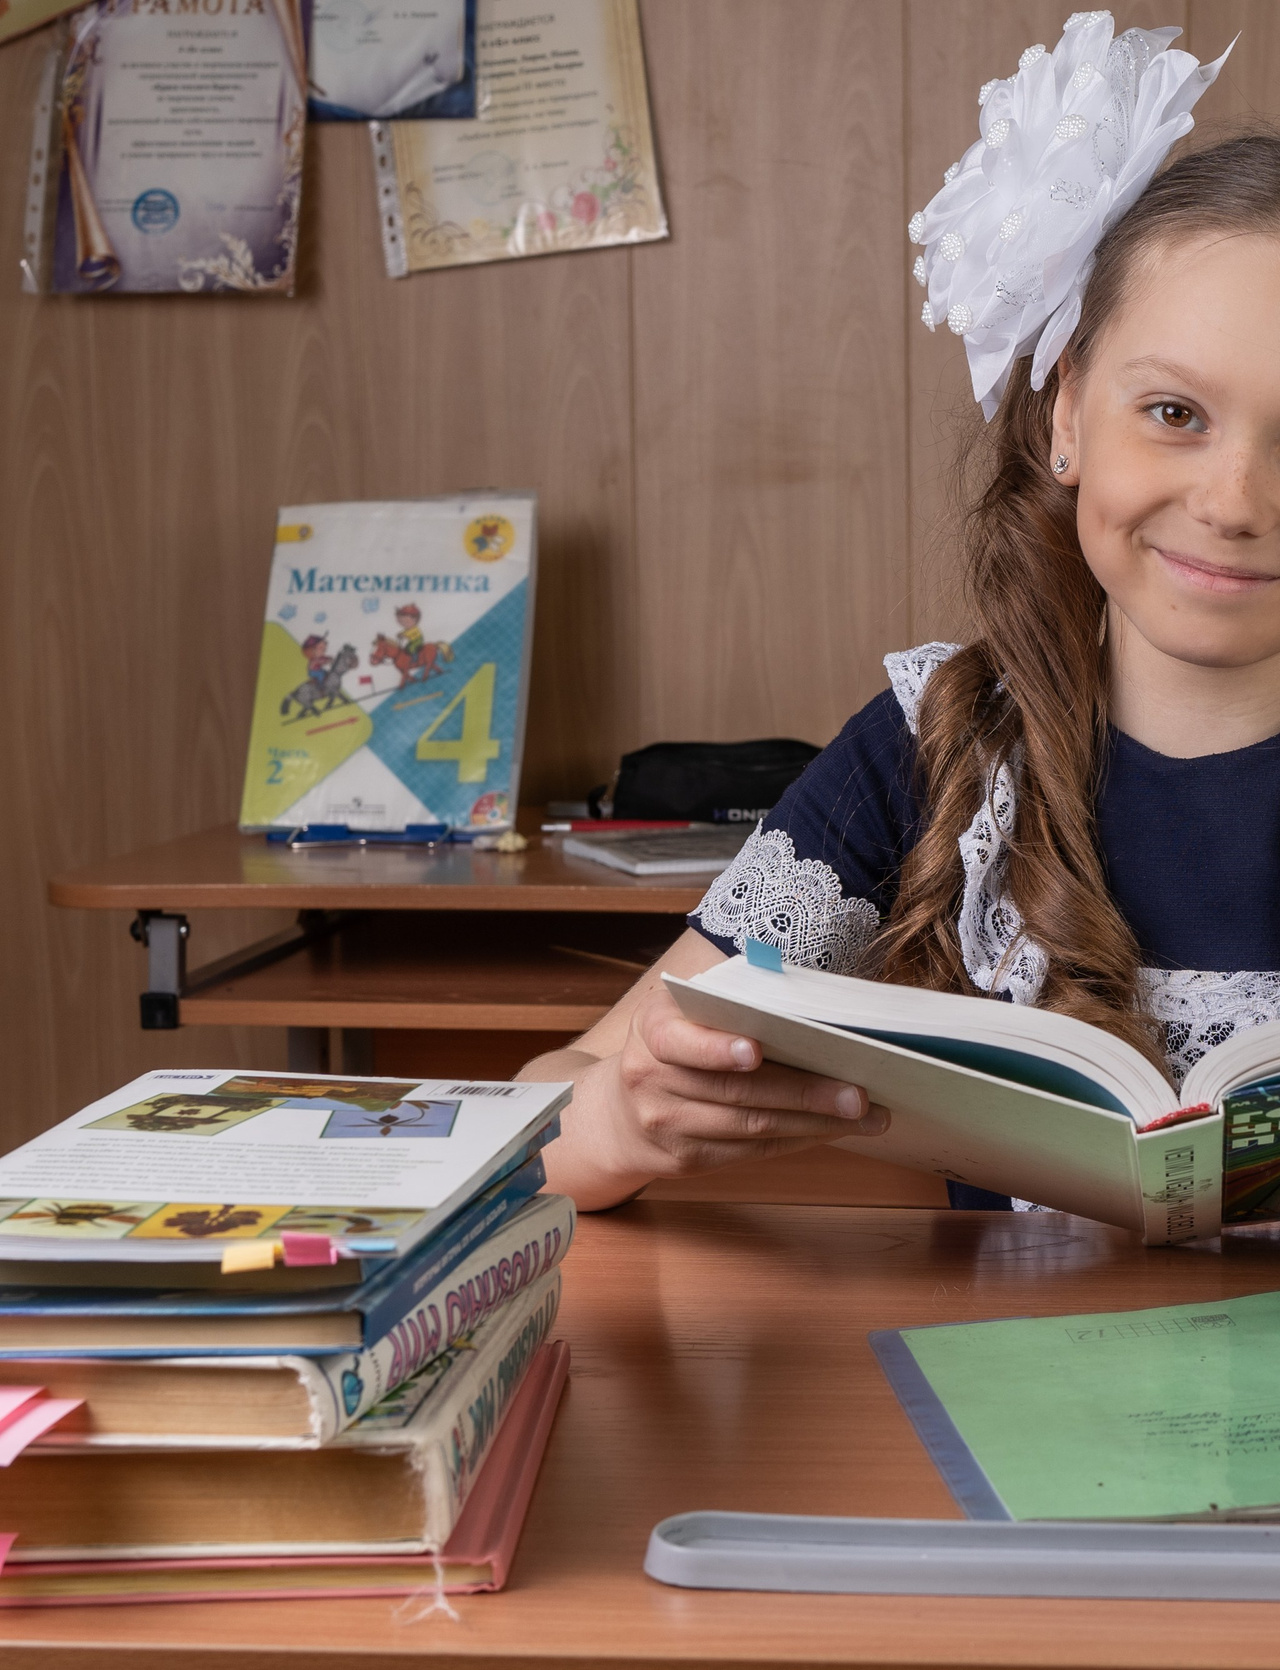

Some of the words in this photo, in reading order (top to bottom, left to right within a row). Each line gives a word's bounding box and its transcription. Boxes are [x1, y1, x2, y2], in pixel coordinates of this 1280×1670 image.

[287, 566, 490, 594] Математика
[416, 662, 500, 783] 4
[265, 759, 284, 785] 2
